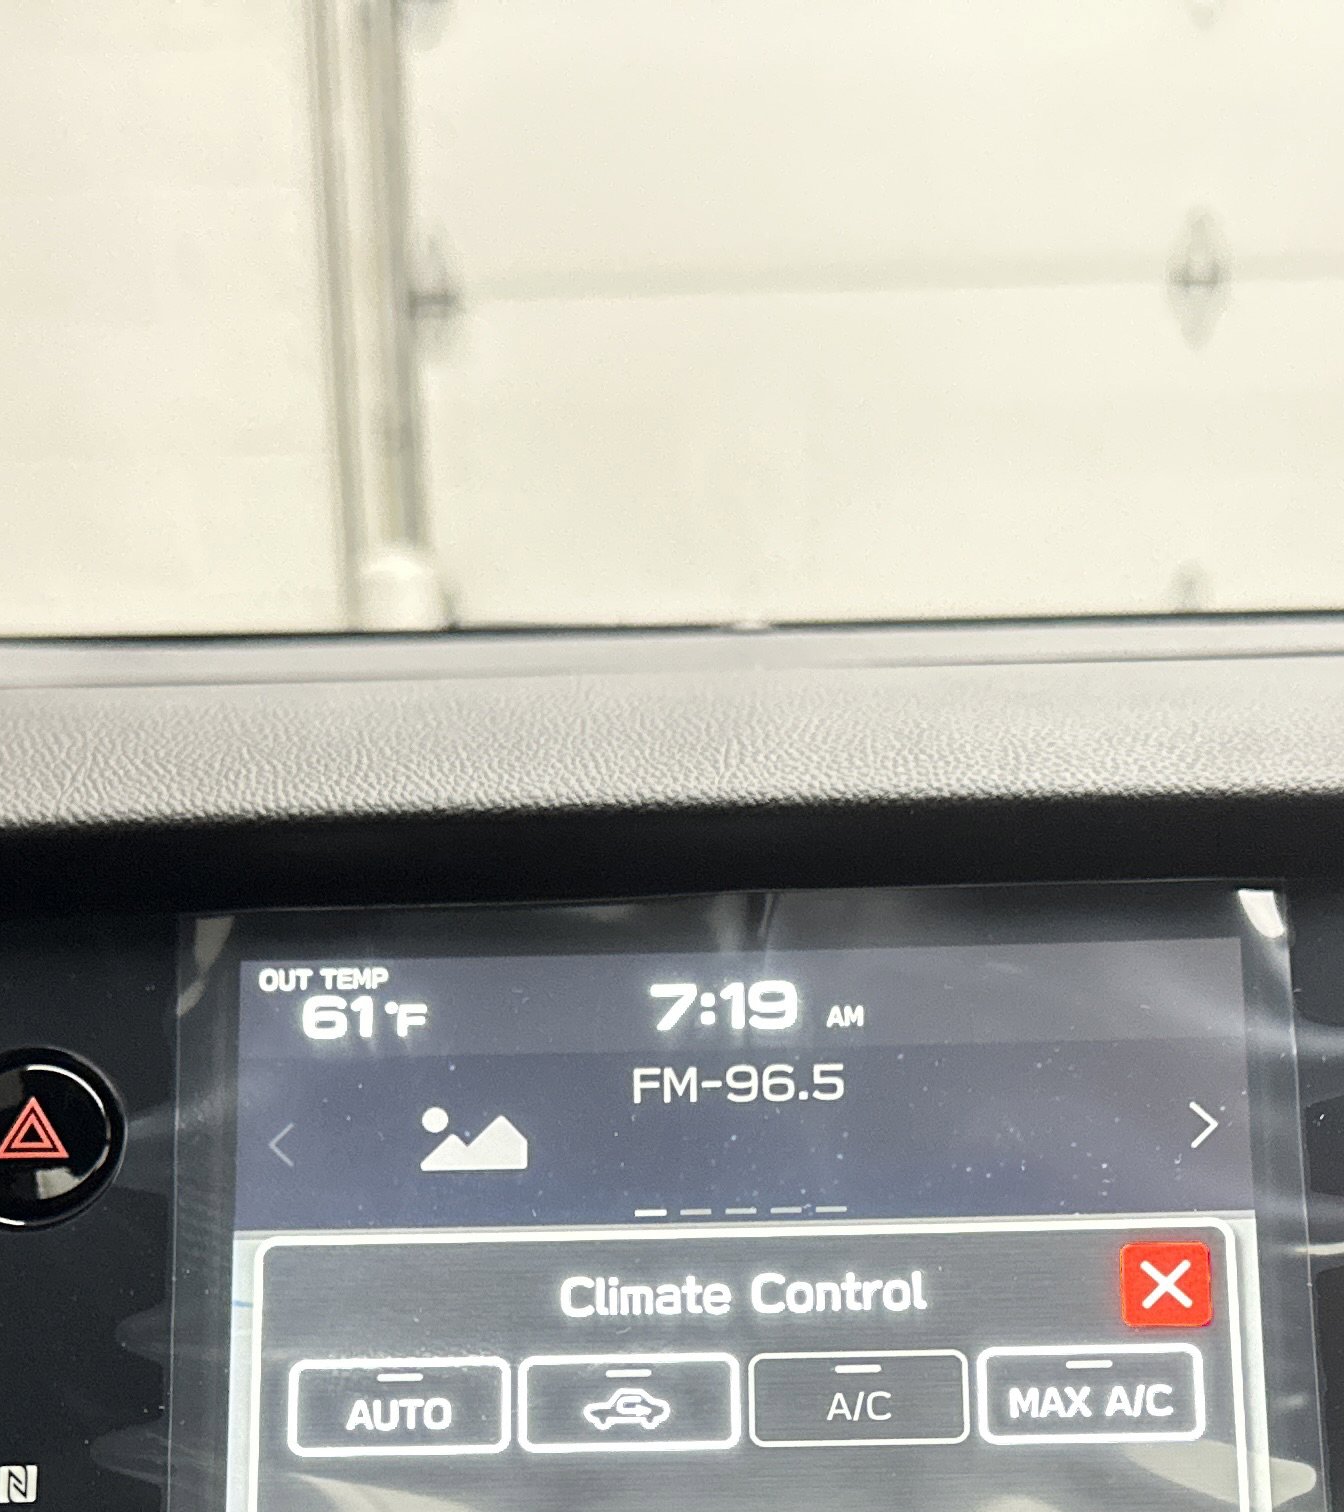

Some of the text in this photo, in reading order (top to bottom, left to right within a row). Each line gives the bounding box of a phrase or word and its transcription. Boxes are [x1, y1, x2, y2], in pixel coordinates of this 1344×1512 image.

[258, 968, 390, 992] OUT TEMP
[649, 980, 865, 1032] 7:19 AM
[632, 1063, 846, 1104] FM-96.5
[560, 1270, 927, 1318] Climate Control
[346, 1395, 453, 1431] AUTO
[826, 1389, 892, 1423] A/C
[1008, 1384, 1173, 1419] MAX A/C
